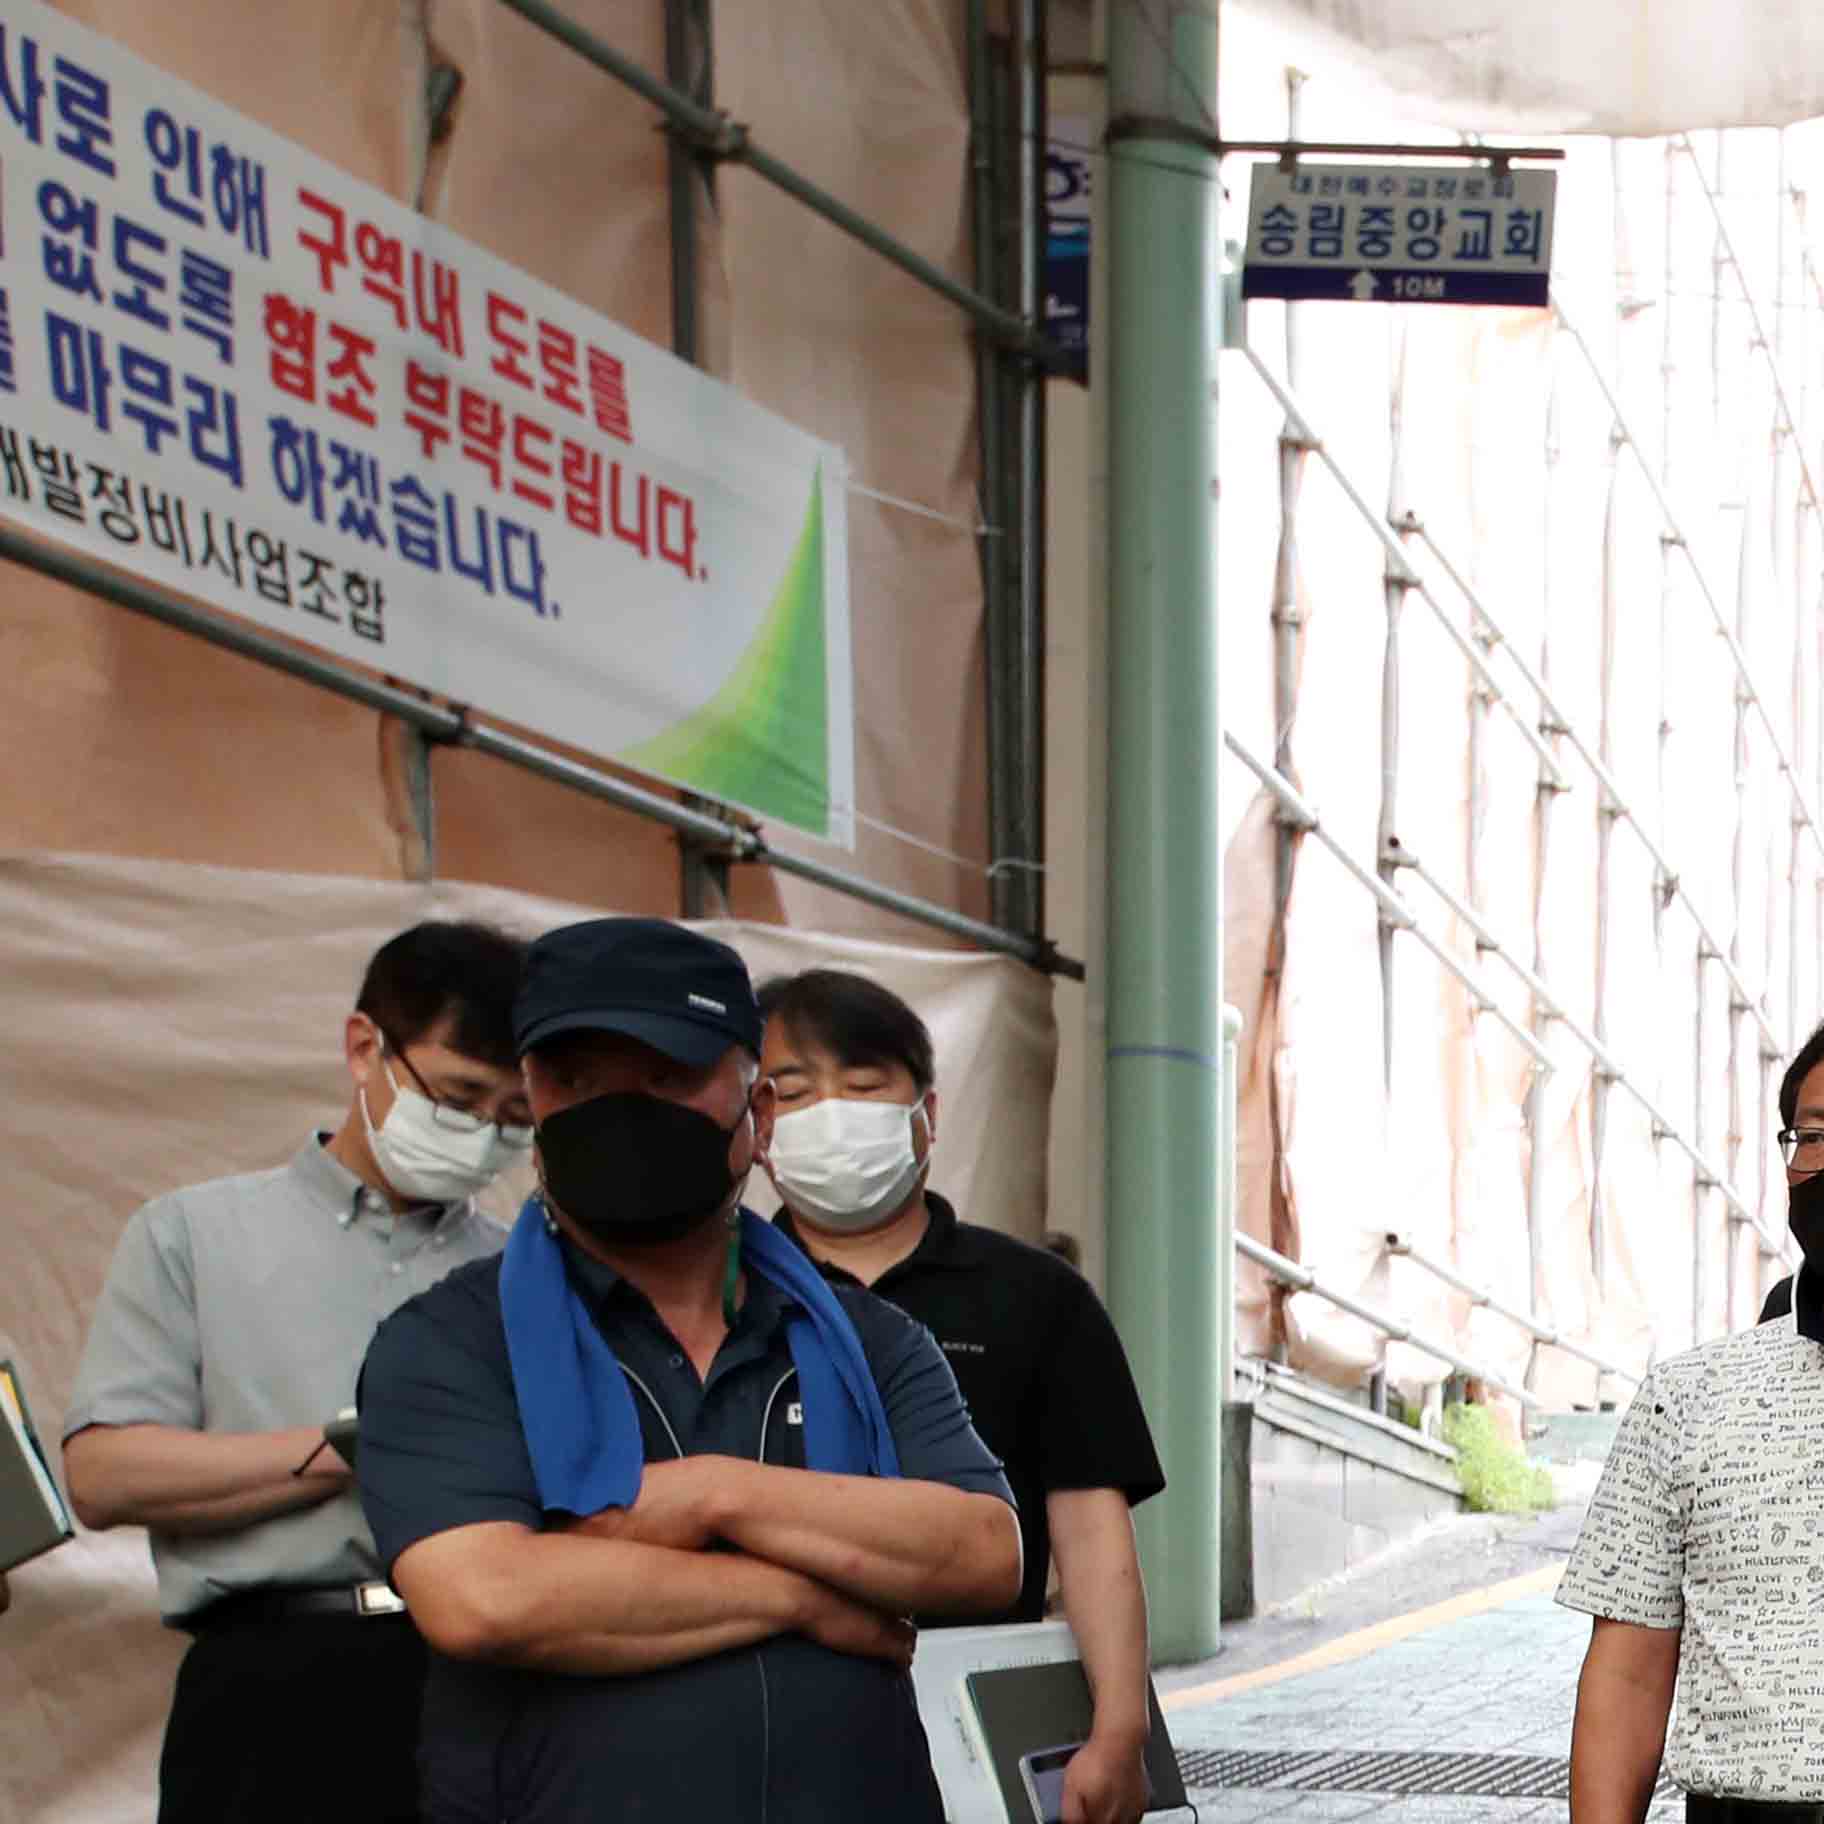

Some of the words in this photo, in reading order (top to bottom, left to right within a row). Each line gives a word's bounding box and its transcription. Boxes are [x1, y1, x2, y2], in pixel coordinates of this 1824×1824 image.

[36, 179, 236, 365] 없도록
[263, 292, 377, 429] 협조
[404, 361, 709, 582] 부탁드립니다.
[144, 107, 270, 261] 인해
[298, 186, 464, 358] 구역내
[485, 289, 634, 444] 도로를
[1258, 202, 1542, 264] 송림중앙교회
[1391, 276, 1446, 298] 10M
[44, 308, 244, 490] 마무리
[267, 413, 562, 619] 하겠습니다.
